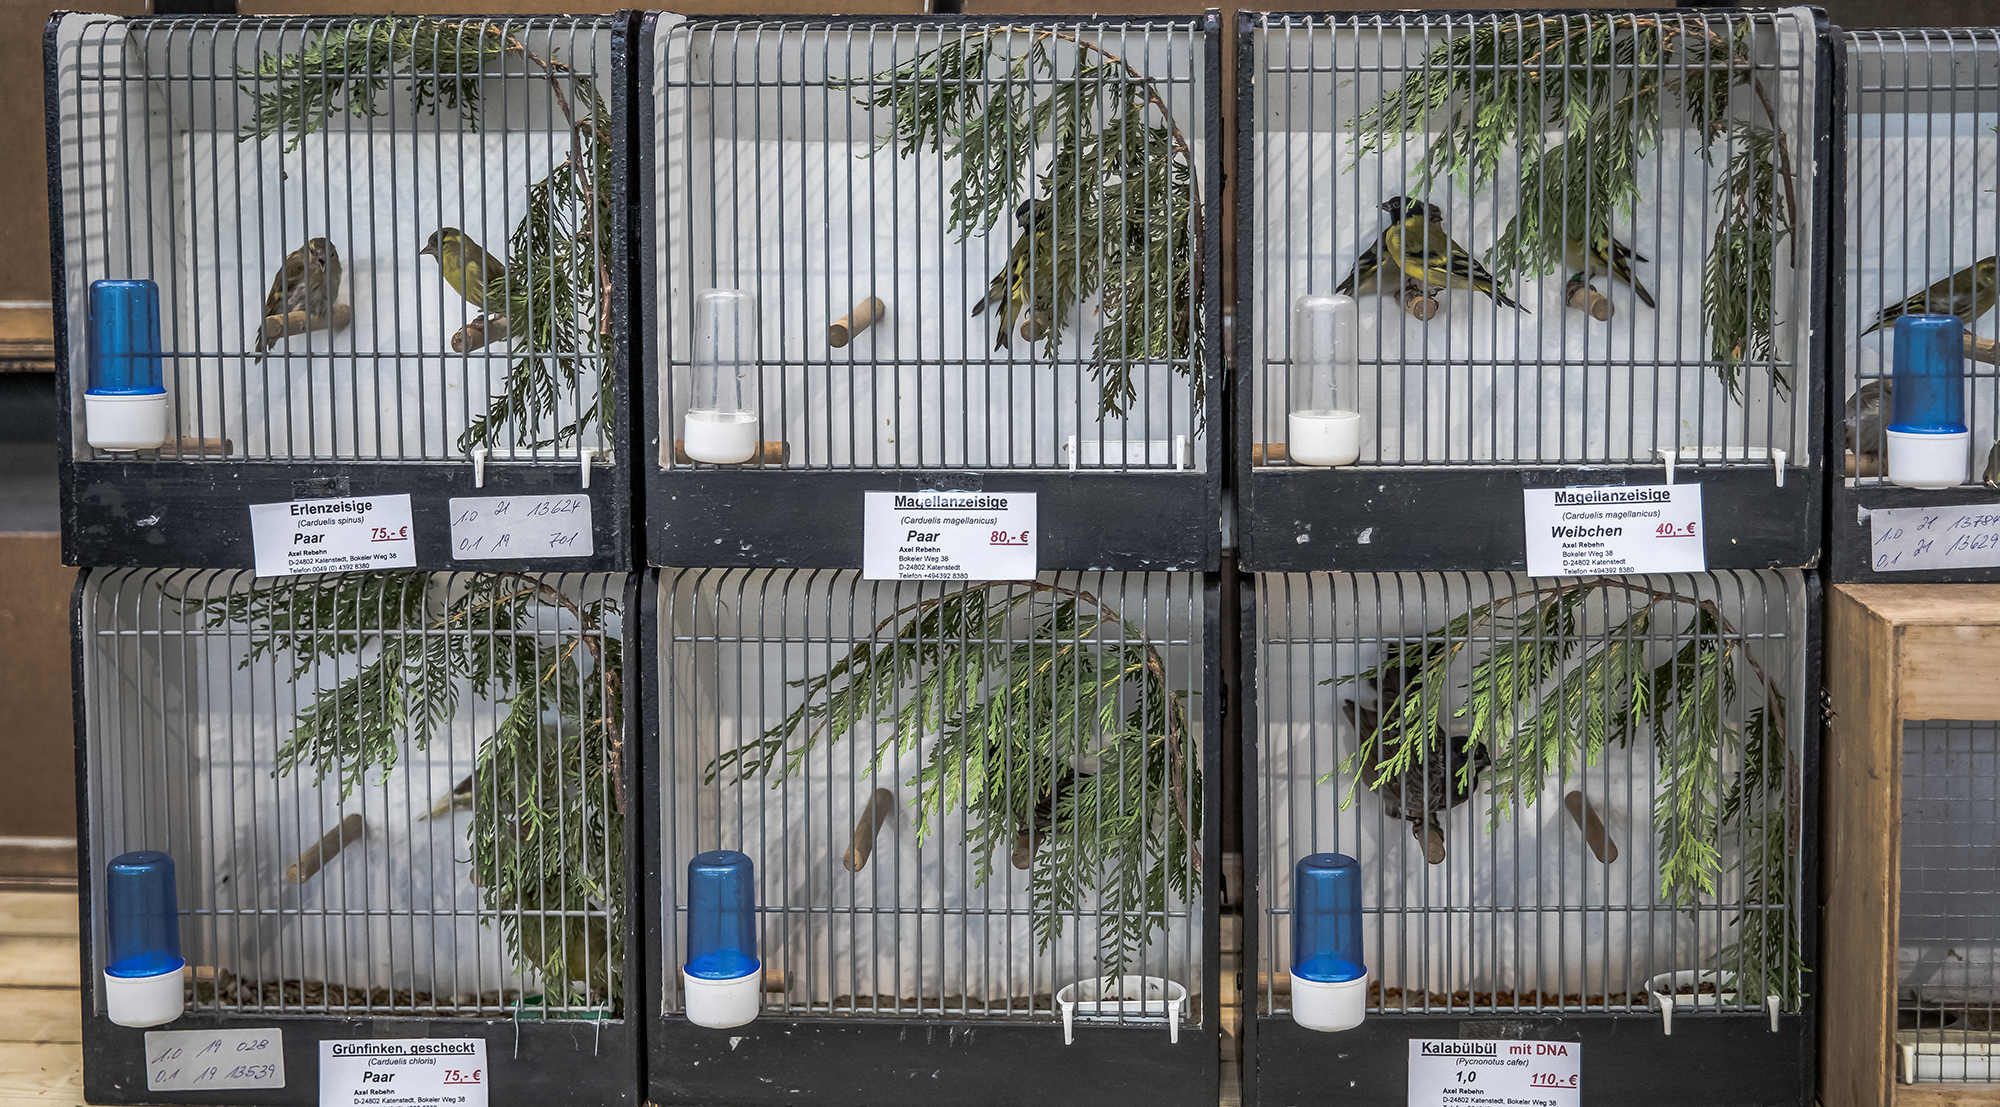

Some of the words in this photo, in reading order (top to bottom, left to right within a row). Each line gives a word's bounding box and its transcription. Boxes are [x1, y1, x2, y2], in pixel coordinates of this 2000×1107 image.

[894, 495, 1008, 510] Magellanzeisige
[1555, 489, 1671, 506] Magellanzeisige
[290, 500, 372, 515] Erlenzeisige
[298, 518, 336, 528] (Carduelis
[338, 516, 364, 525] spinus)
[901, 517, 941, 525] (Carduelis
[943, 517, 997, 526] magellanicus)
[1562, 512, 1603, 521] (Carduelis
[1605, 510, 1661, 519] magellanicus)
[371, 528, 395, 542] 75,-
[399, 526, 407, 539] €
[907, 530, 940, 542] Paar
[1551, 526, 1622, 538] Weibchen
[1656, 523, 1682, 538] 40,-
[1687, 522, 1696, 537] €
[294, 533, 325, 545] Paar
[491, 534, 510, 552] 19
[990, 531, 1016, 545] 80,-
[1020, 531, 1029, 545] €
[196, 1039, 222, 1058] 19
[332, 1044, 407, 1057] Grünfinken,
[410, 1042, 475, 1056] gescheckt
[1421, 1042, 1497, 1057] Kalabülbül
[1509, 1044, 1532, 1055] mit
[1536, 1044, 1568, 1056] DNA
[368, 1058, 407, 1066] (Carduelis
[1456, 1058, 1504, 1066] (Pycnonotus
[1507, 1059, 1529, 1067] cafer)
[193, 1067, 217, 1083] 19
[363, 1072, 395, 1083] Paar
[443, 1070, 469, 1084] 75,-
[472, 1069, 481, 1084] €
[1456, 1071, 1477, 1084] 1,0
[1530, 1073, 1564, 1088] 110,-
[1568, 1075, 1578, 1089] €
